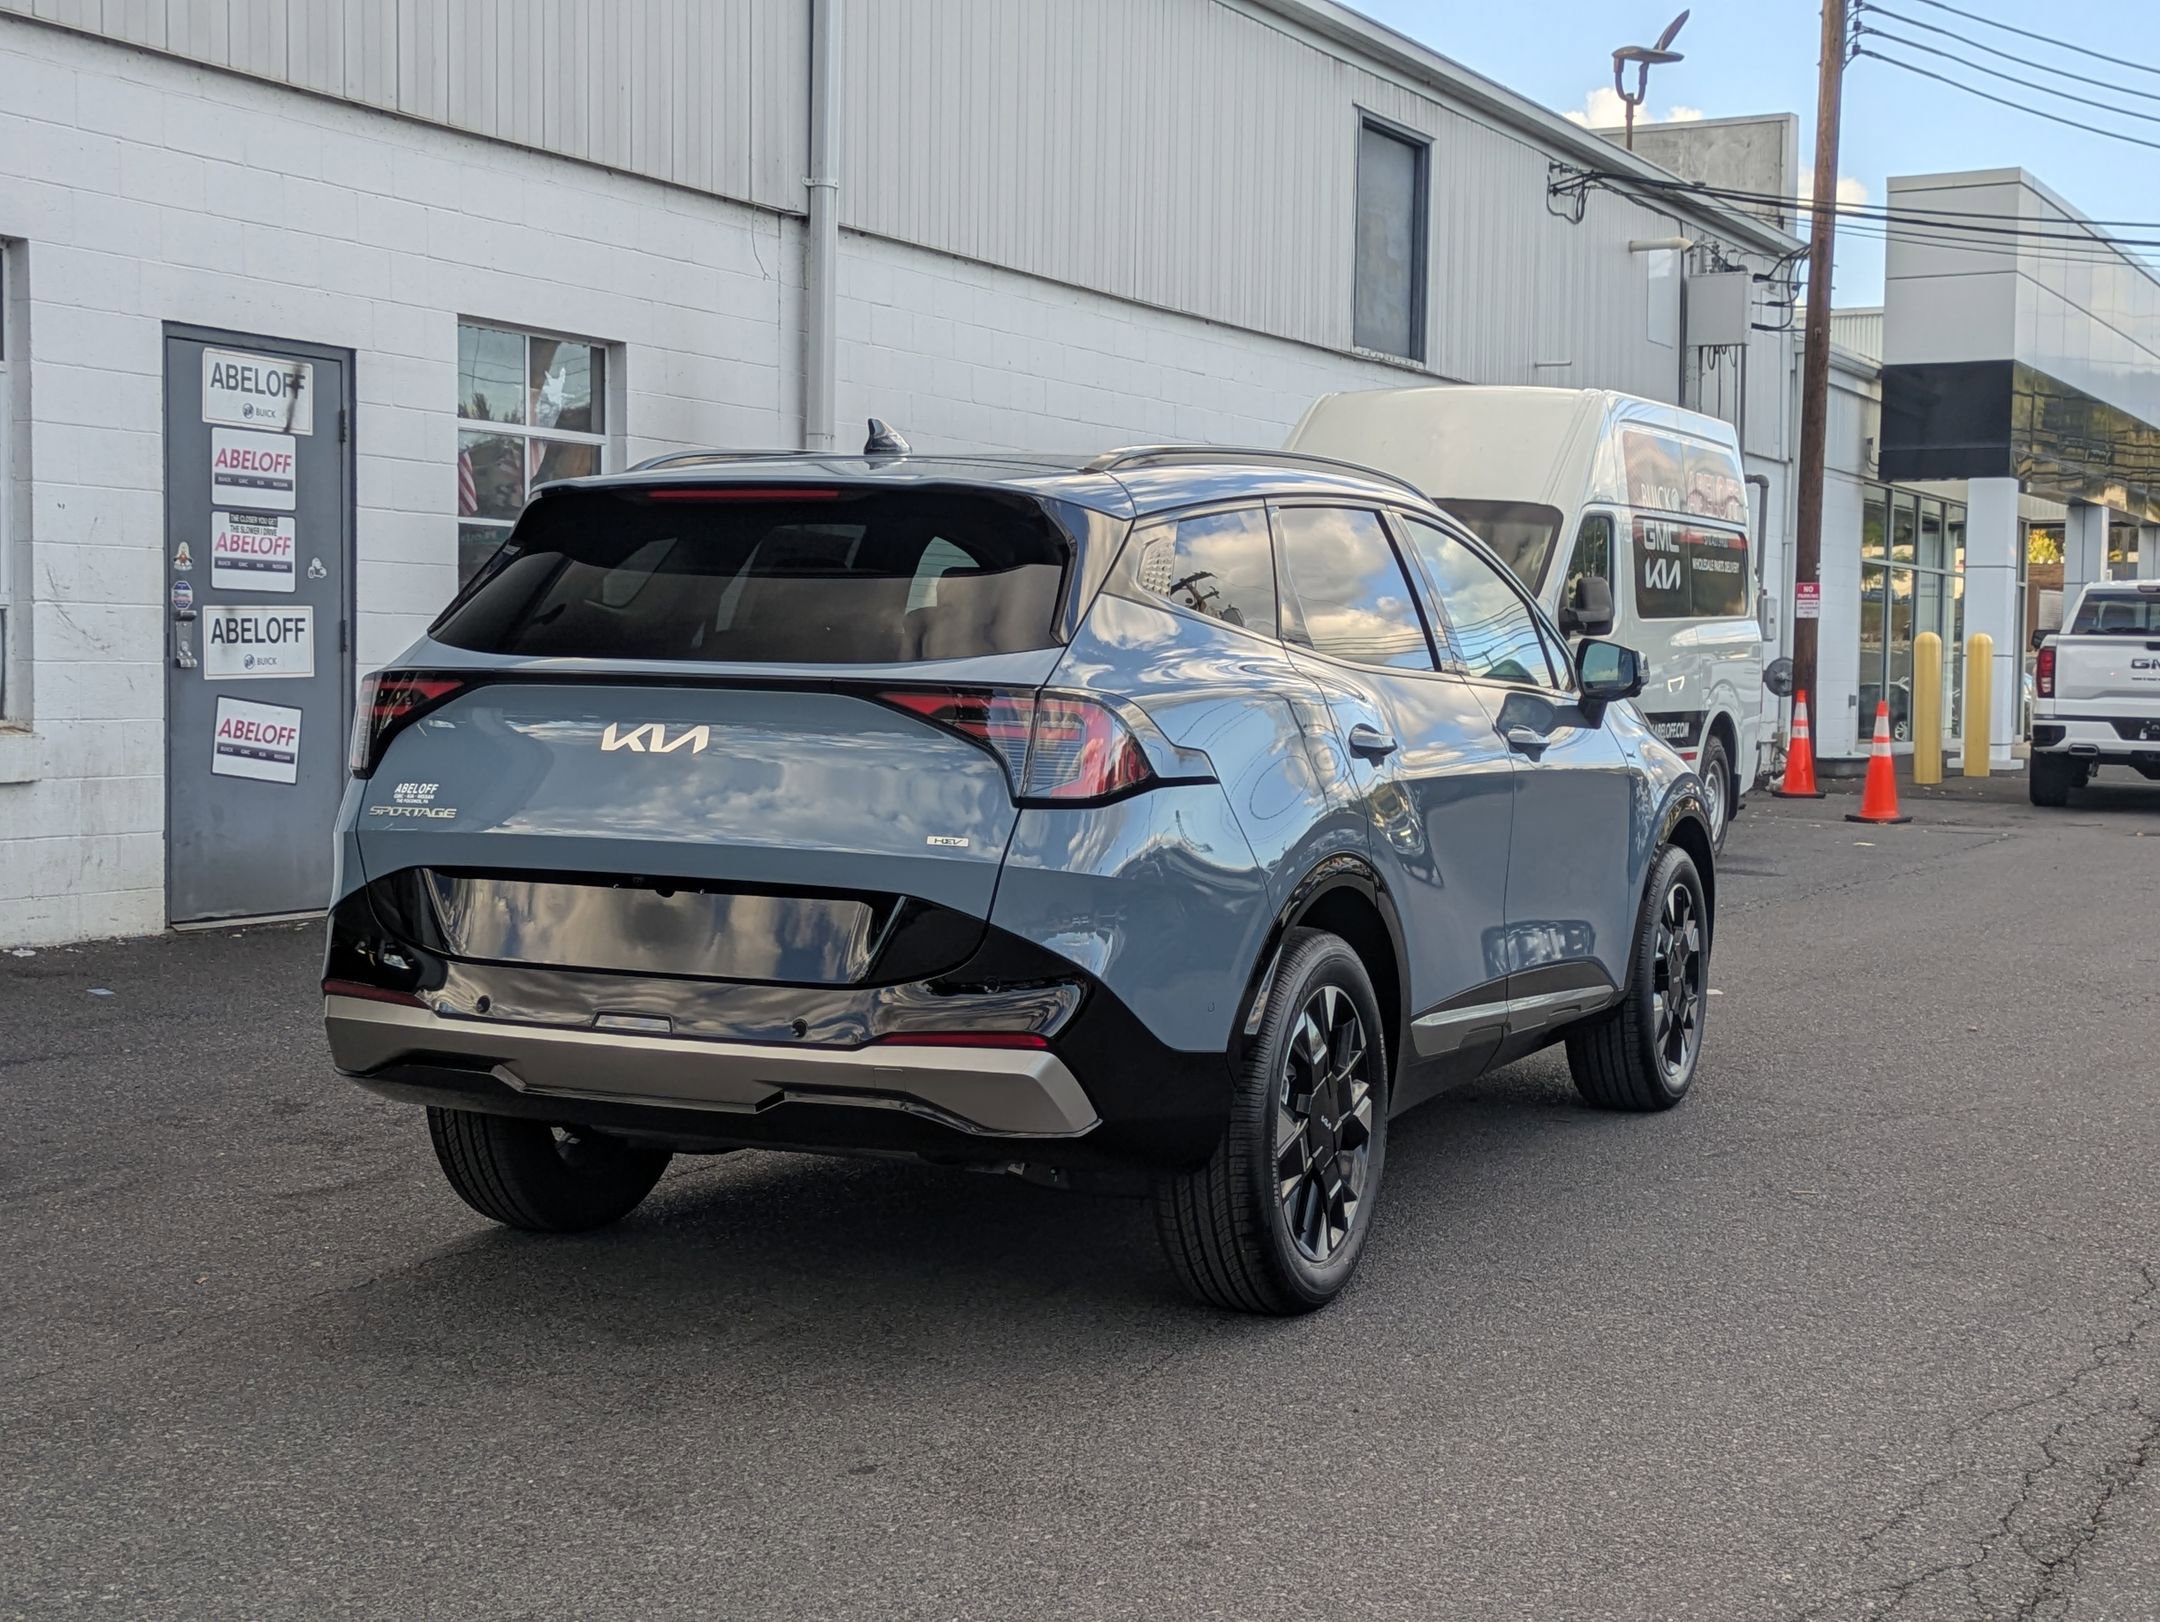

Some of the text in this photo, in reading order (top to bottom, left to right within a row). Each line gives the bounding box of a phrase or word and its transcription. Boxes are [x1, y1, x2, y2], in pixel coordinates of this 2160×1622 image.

[210, 362, 306, 400] ABELOFF
[256, 407, 276, 418] BUICK
[215, 447, 292, 474] ABELOFF
[230, 514, 239, 522] THE
[240, 515, 258, 524] CLOSER
[230, 525, 239, 533] THE
[240, 526, 260, 536] SLOWER
[214, 532, 292, 556] ABELOFF
[1643, 519, 1681, 552] GMC
[1645, 557, 1681, 590] KIA
[1803, 585, 1815, 593] NO
[211, 617, 306, 645] ABELOFF
[256, 657, 277, 666] BUICK
[218, 718, 297, 746] ABELOFF
[601, 722, 710, 754] KIA
[394, 783, 439, 794] ABELOFF
[369, 805, 457, 818] SPORTAGE
